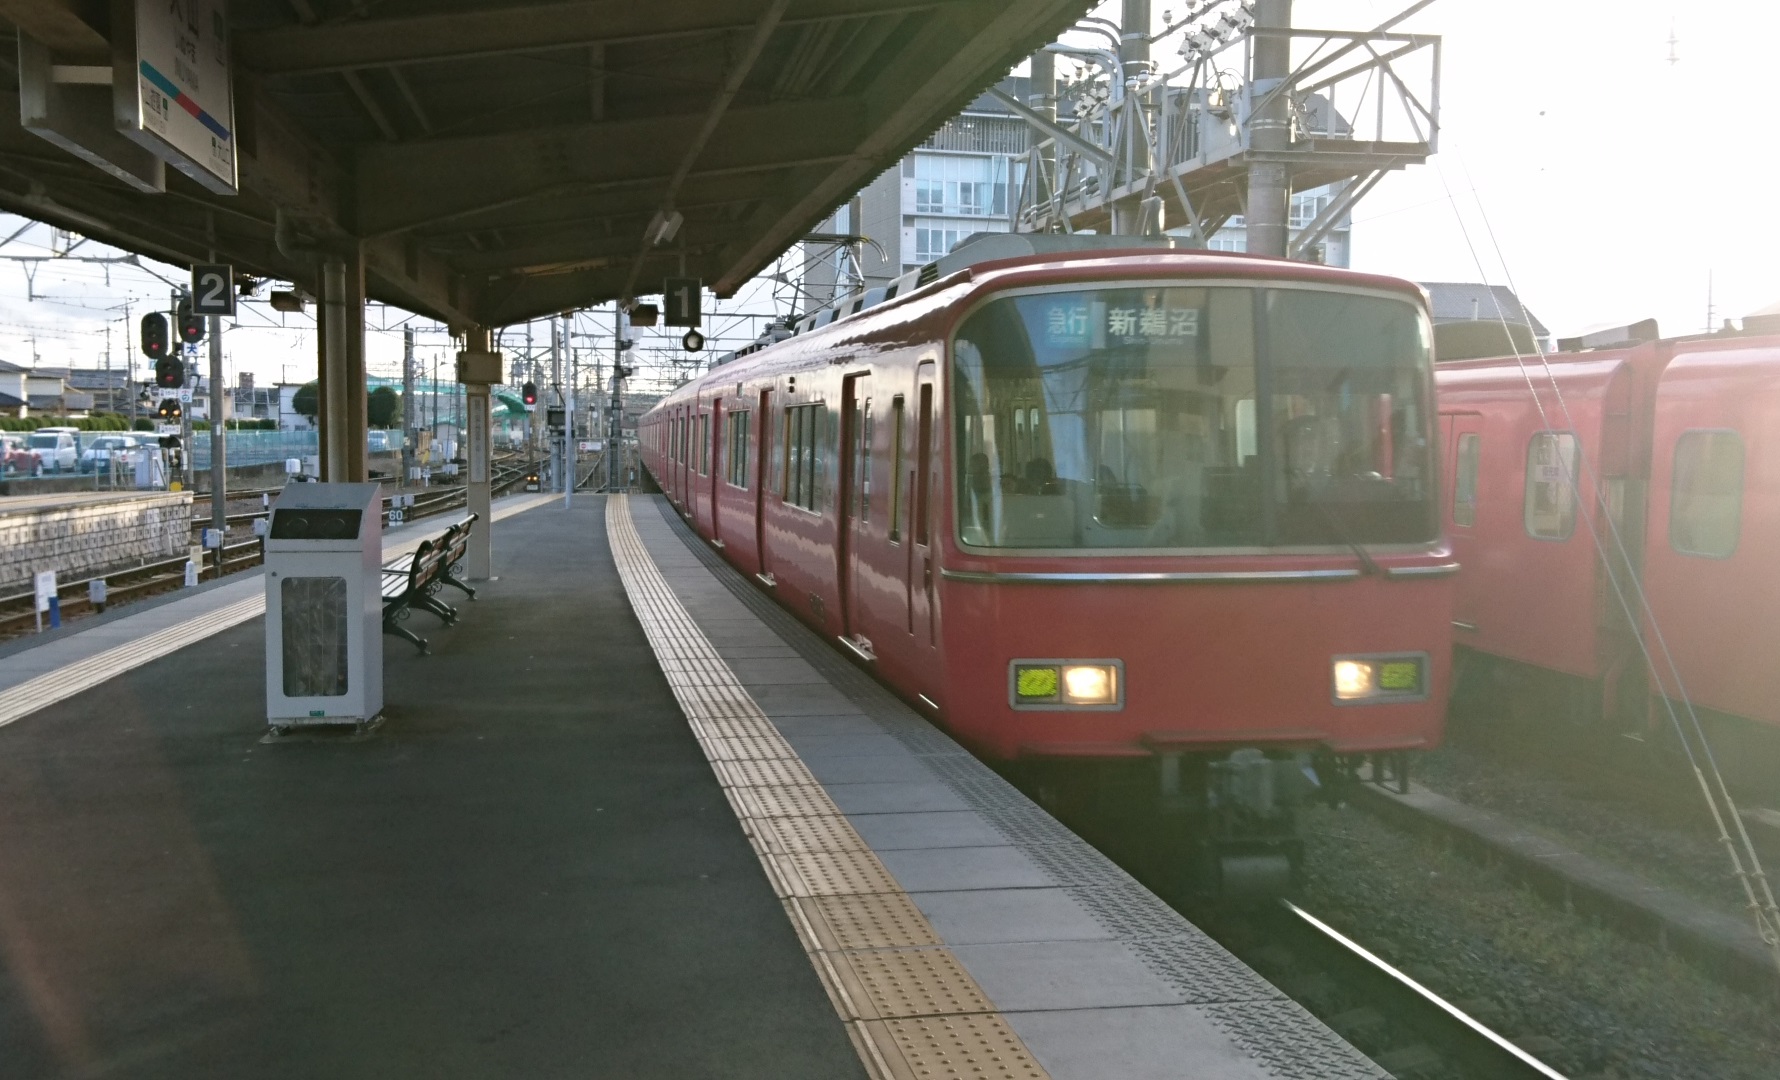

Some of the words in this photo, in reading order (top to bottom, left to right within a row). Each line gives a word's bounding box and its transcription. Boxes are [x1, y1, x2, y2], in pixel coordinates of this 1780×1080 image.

[200, 272, 225, 307] 2
[674, 286, 689, 318] 1
[1047, 307, 1088, 335] 急行
[1108, 307, 1199, 336] 新鵜沼
[388, 510, 403, 521] 60
